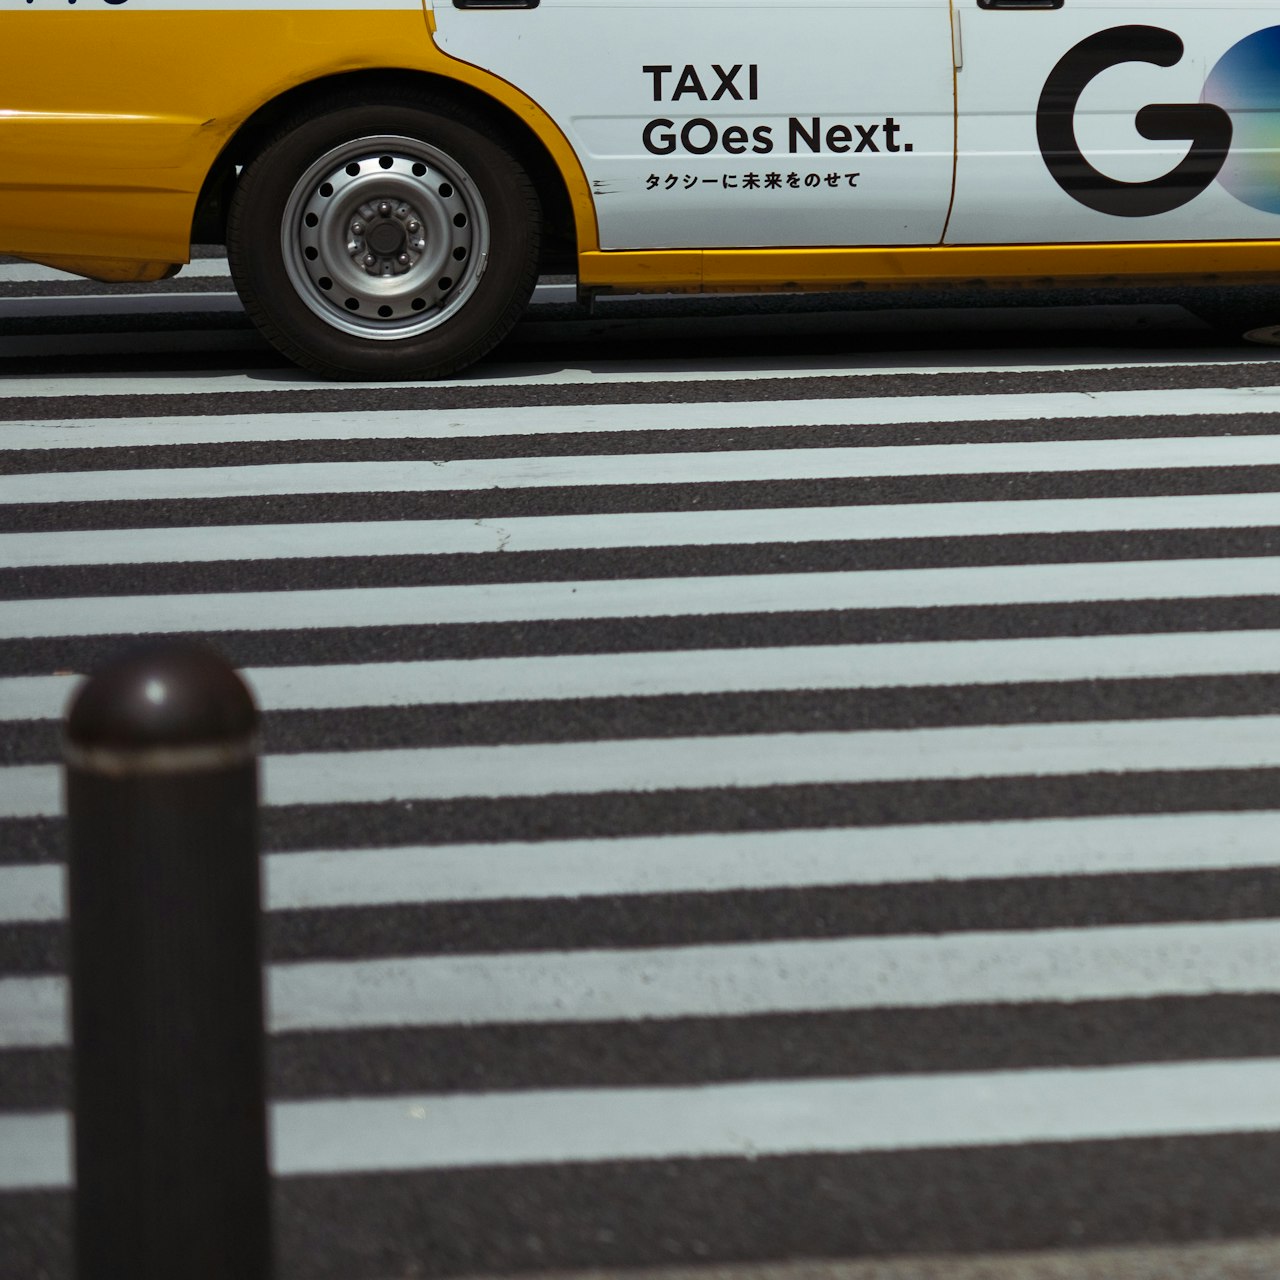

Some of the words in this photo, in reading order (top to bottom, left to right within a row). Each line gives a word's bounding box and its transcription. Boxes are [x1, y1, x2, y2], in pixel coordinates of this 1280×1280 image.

[642, 64, 758, 101] TAXI
[642, 118, 774, 156] GOes
[788, 117, 914, 154] Next.
[645, 172, 861, 190] タクシーに未来をのせて
